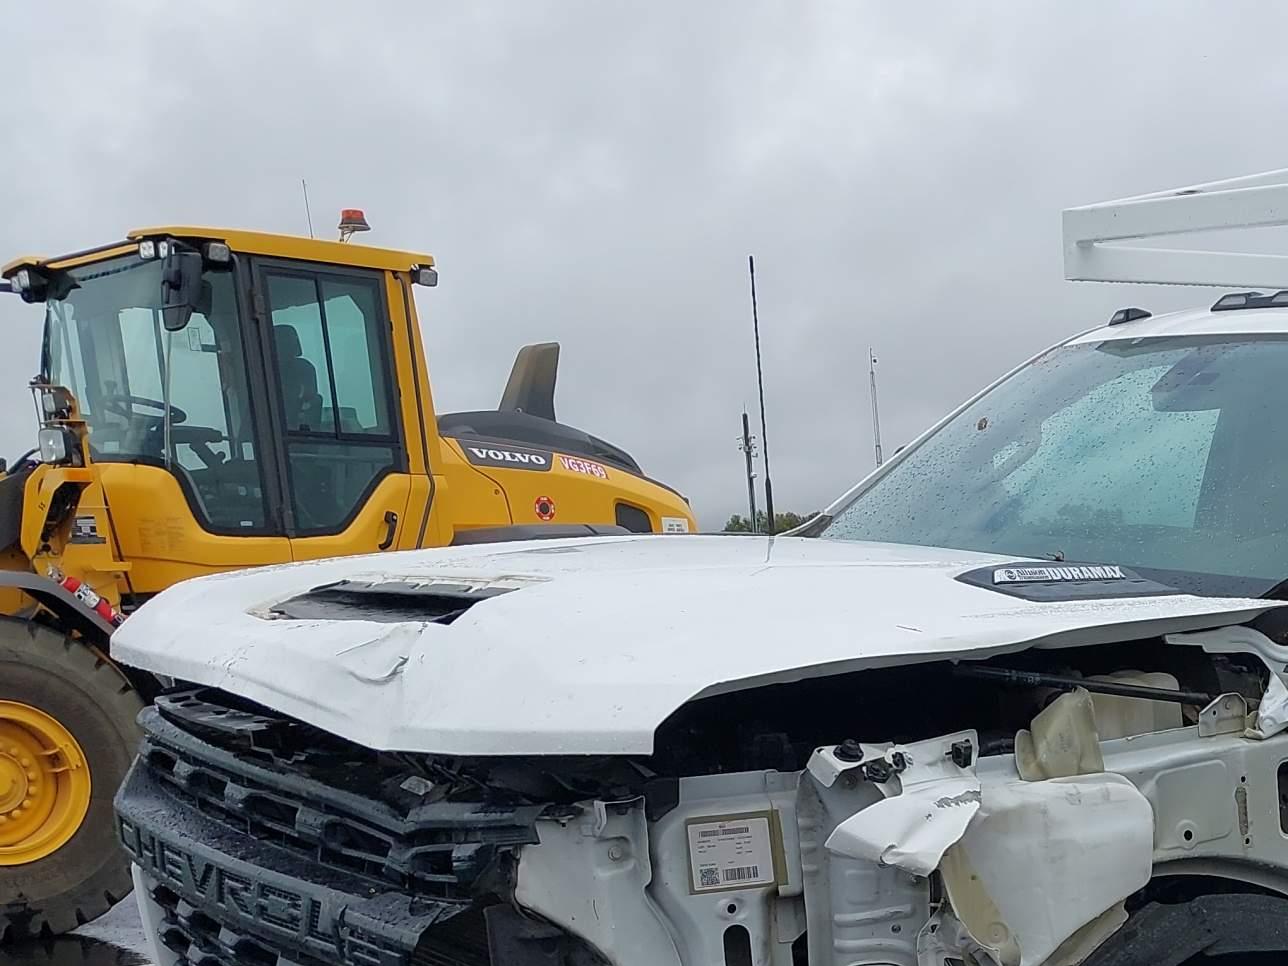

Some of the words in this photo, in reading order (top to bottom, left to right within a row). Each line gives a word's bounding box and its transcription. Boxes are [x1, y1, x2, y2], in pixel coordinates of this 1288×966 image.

[468, 447, 546, 465] VOLVO
[560, 456, 606, 479] VG3F69
[1049, 566, 1126, 580] DURAMAX
